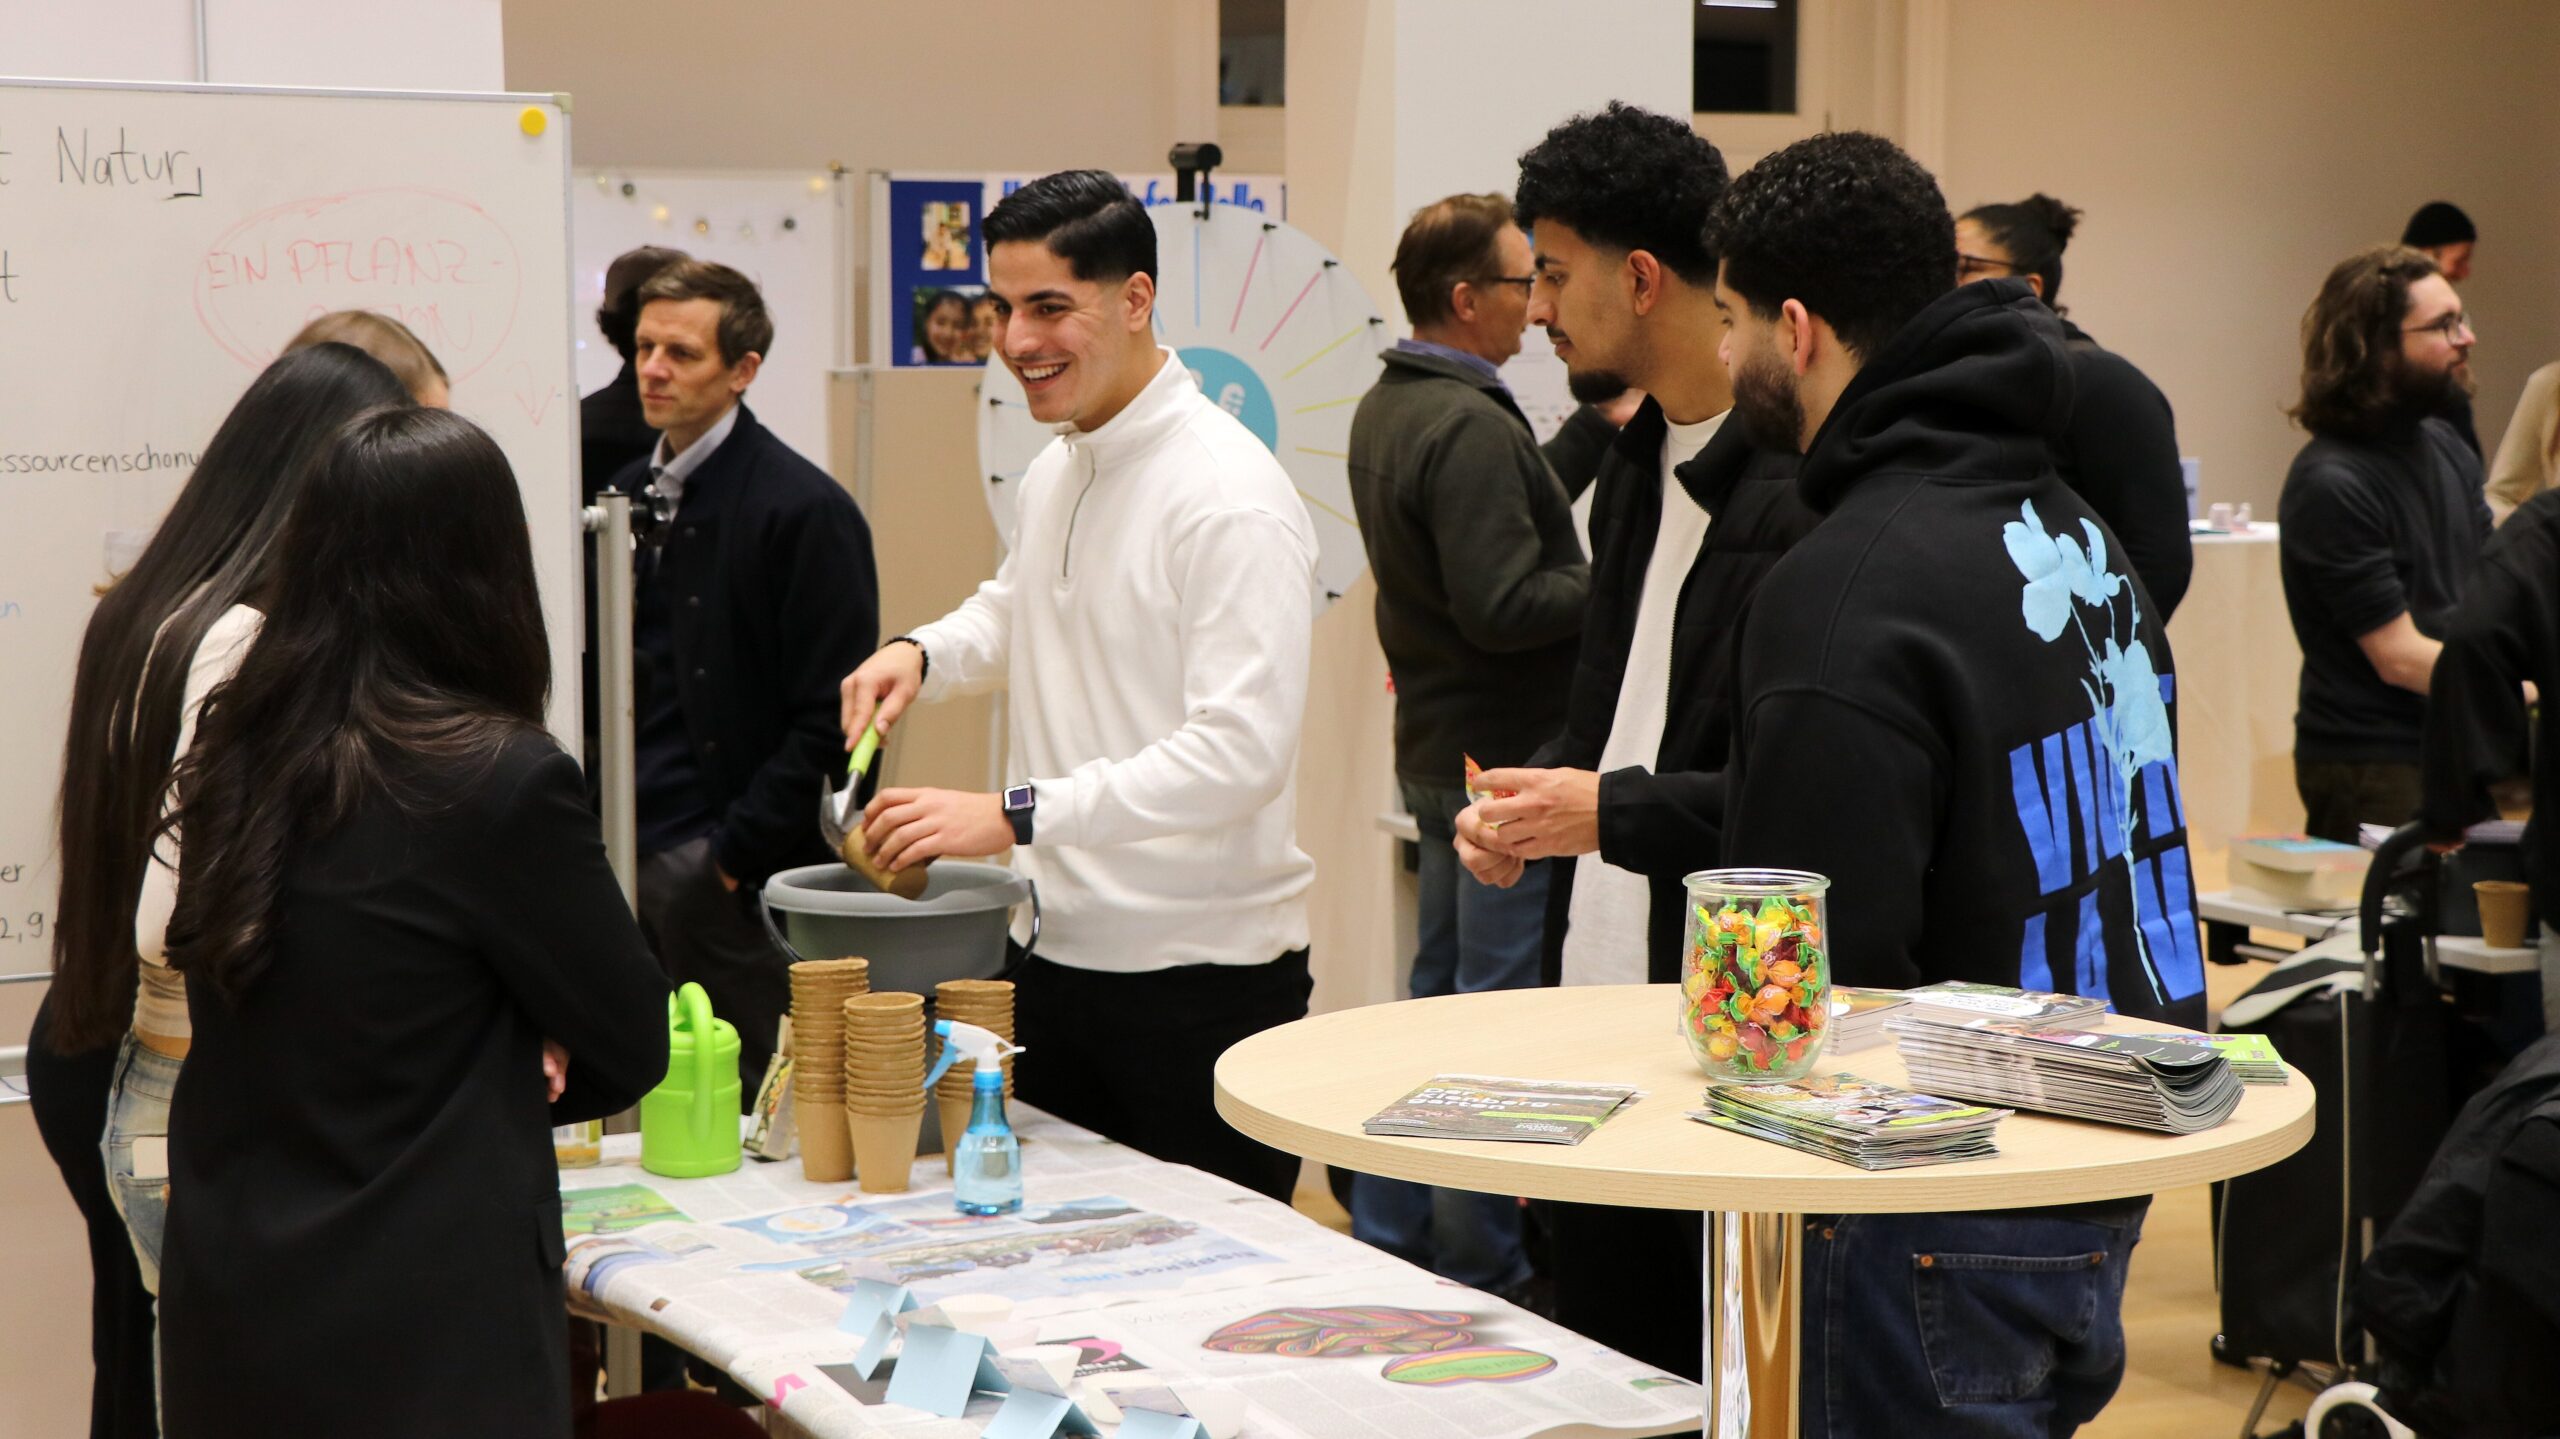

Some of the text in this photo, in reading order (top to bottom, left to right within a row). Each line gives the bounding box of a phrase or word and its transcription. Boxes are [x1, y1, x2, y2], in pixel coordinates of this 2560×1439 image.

[57, 125, 190, 186] Natur
[205, 241, 268, 289] EIN
[0, 442, 201, 475] ssourcenschonu
